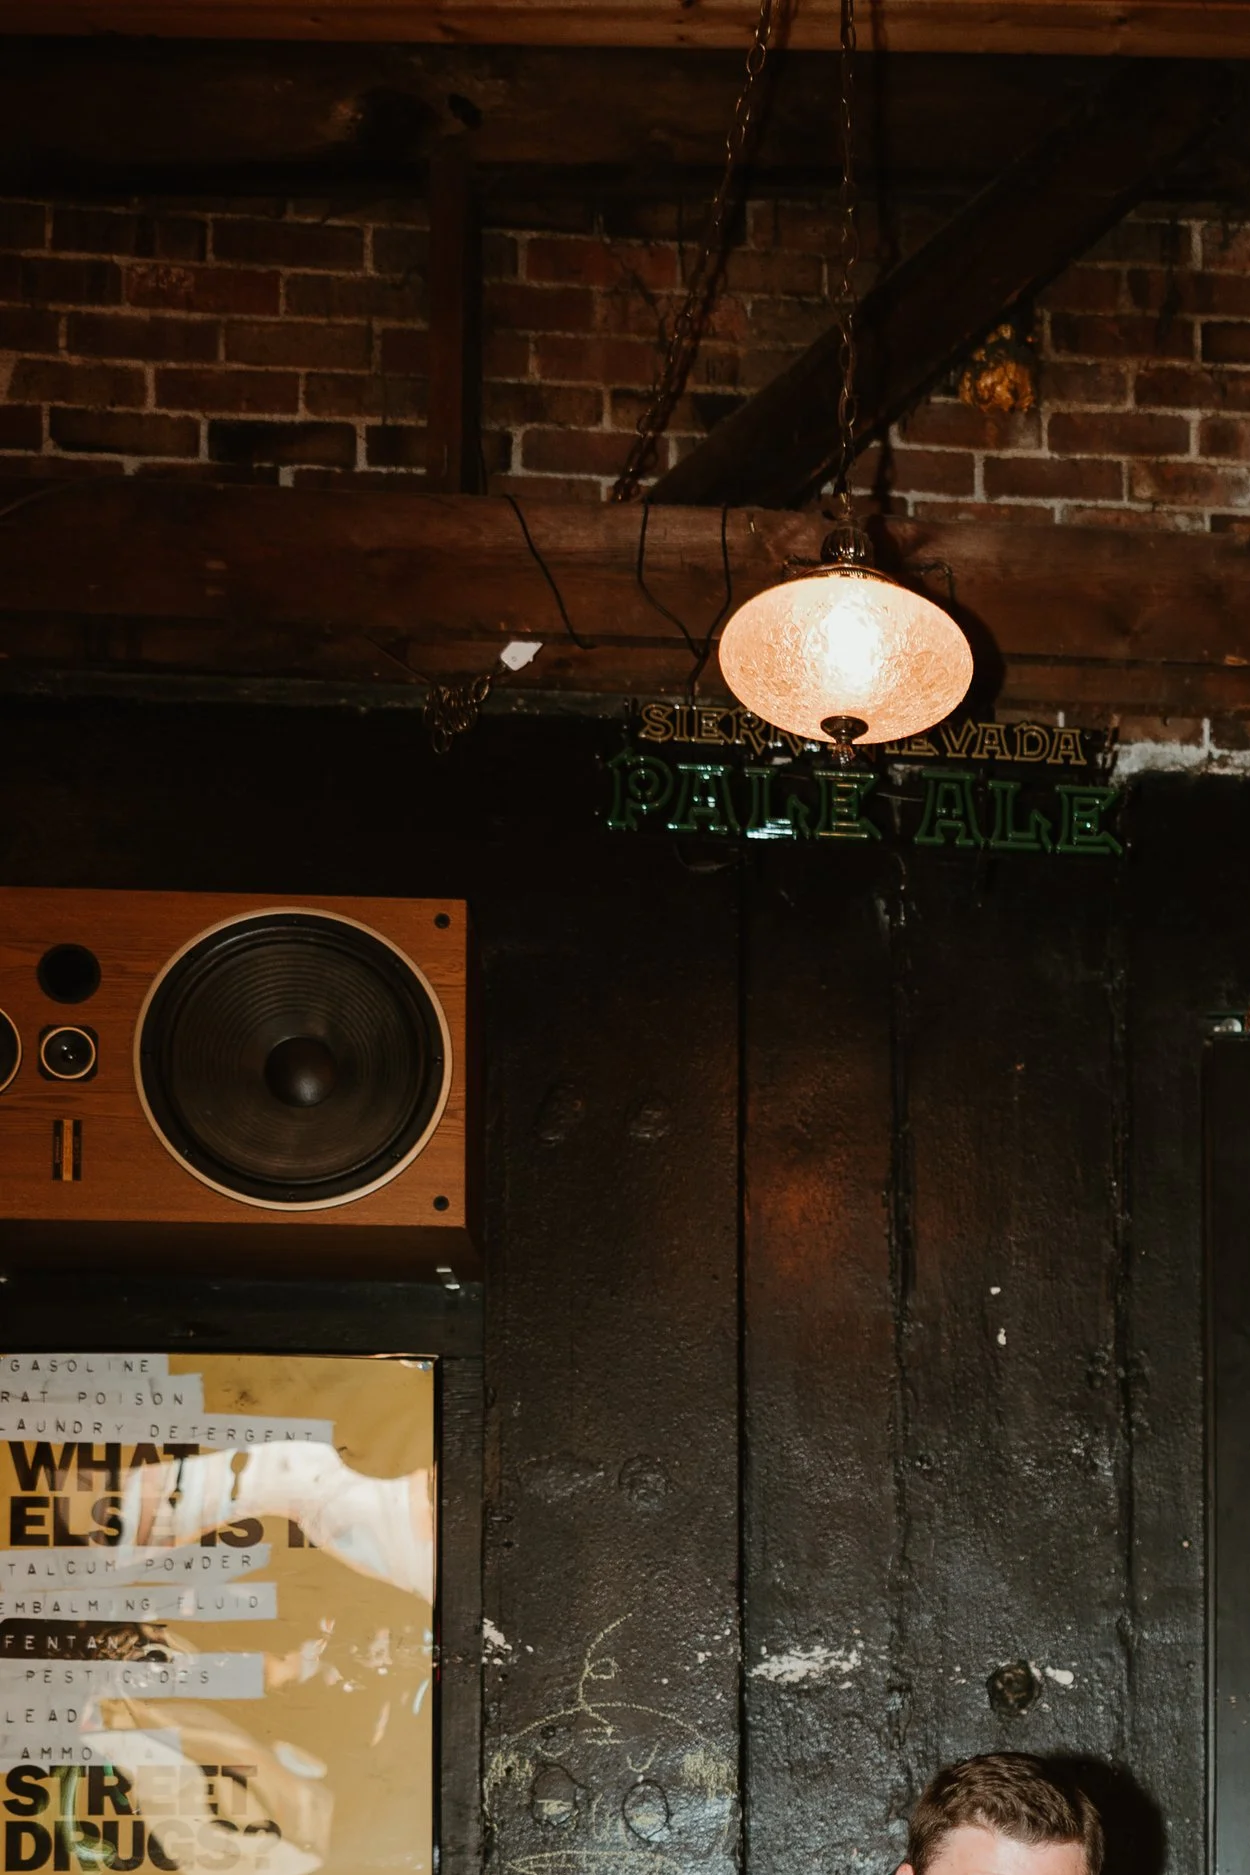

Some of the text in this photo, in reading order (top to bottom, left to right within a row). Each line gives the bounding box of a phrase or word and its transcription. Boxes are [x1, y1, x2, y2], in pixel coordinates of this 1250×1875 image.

[637, 702, 1088, 765] SIER EVADA
[607, 750, 1123, 855] PALE ALE
[10, 1359, 149, 1373] GASOLINE
[1, 1391, 183, 1406] RAT POISON
[150, 1424, 313, 1443] DETERGENT
[8, 1555, 251, 1576] TALCUM POWDER
[177, 1596, 259, 1610] FLUID
[6, 1708, 78, 1723] LEAD
[3, 1765, 257, 1817] STREET
[5, 1819, 282, 1872] DRUGS?
